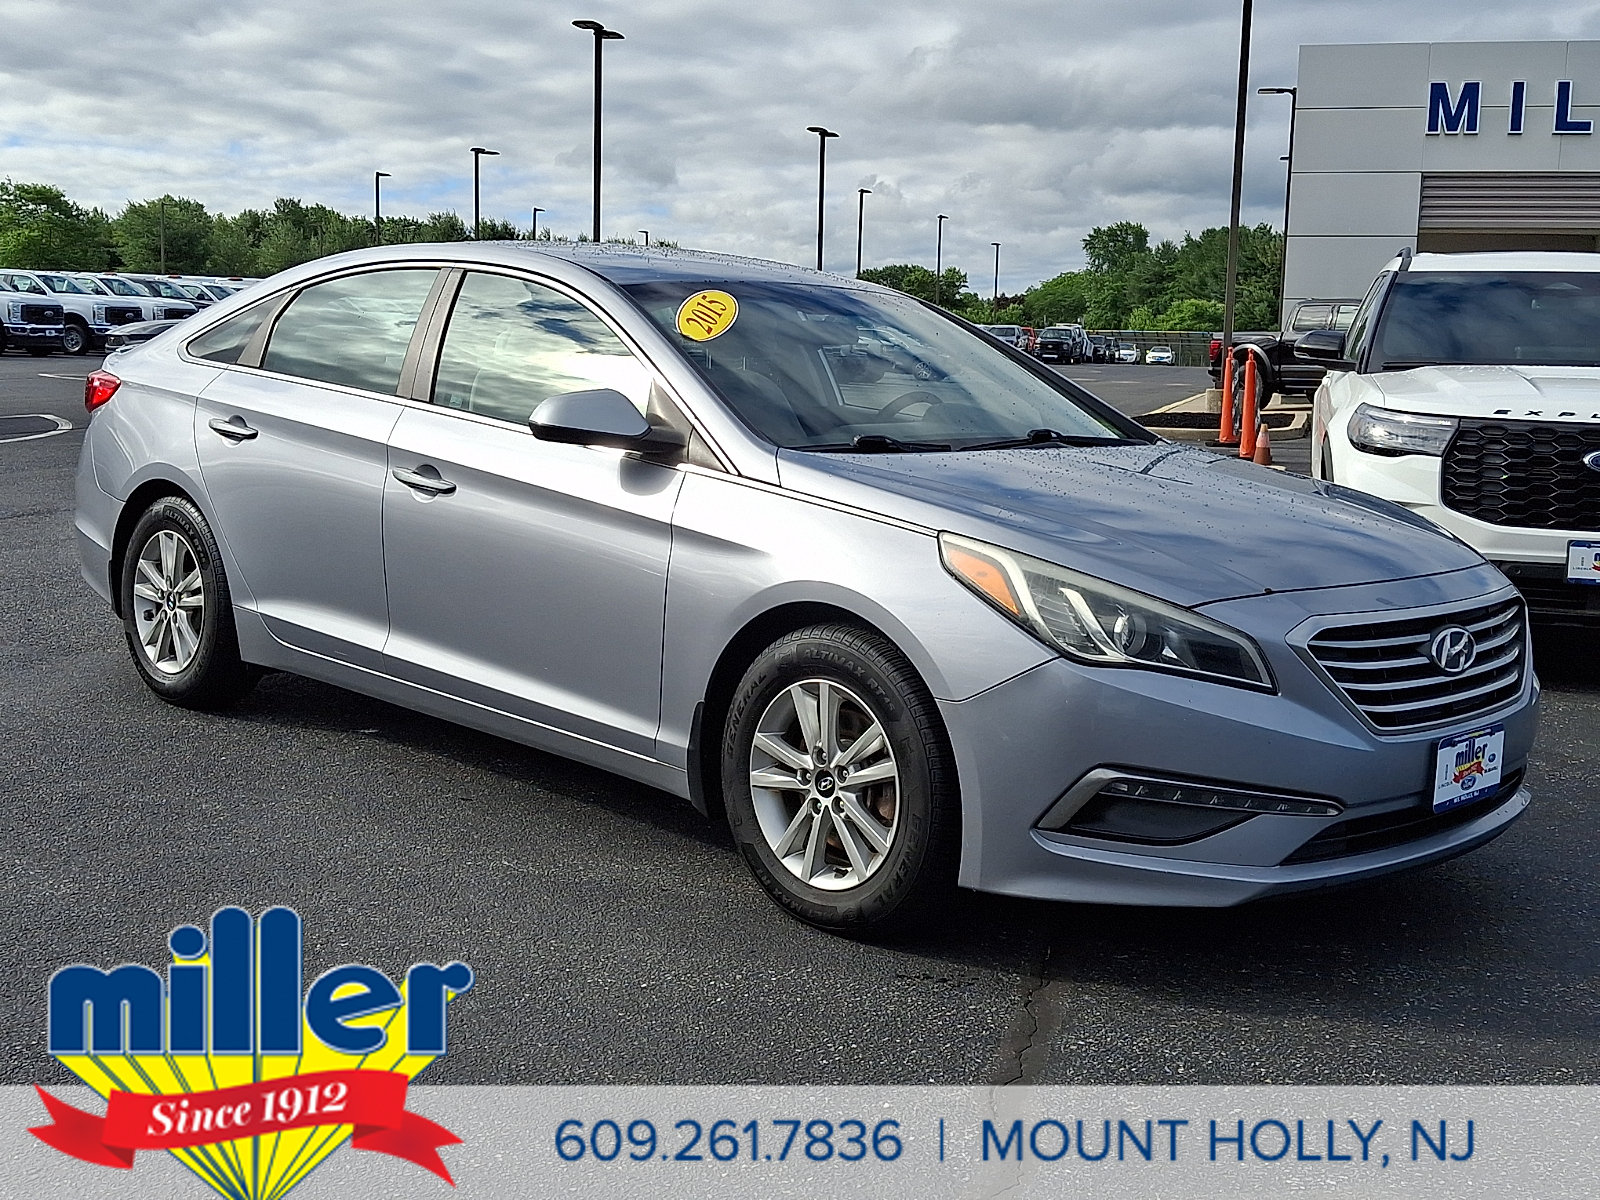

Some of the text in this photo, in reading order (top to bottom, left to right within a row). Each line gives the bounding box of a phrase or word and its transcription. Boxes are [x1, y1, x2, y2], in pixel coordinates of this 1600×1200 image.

[1425, 79, 1594, 136] MIL
[685, 295, 727, 335] 2015
[803, 647, 866, 677] ALTIMAX
[726, 672, 768, 755] GENERAL
[1455, 738, 1488, 767] miller
